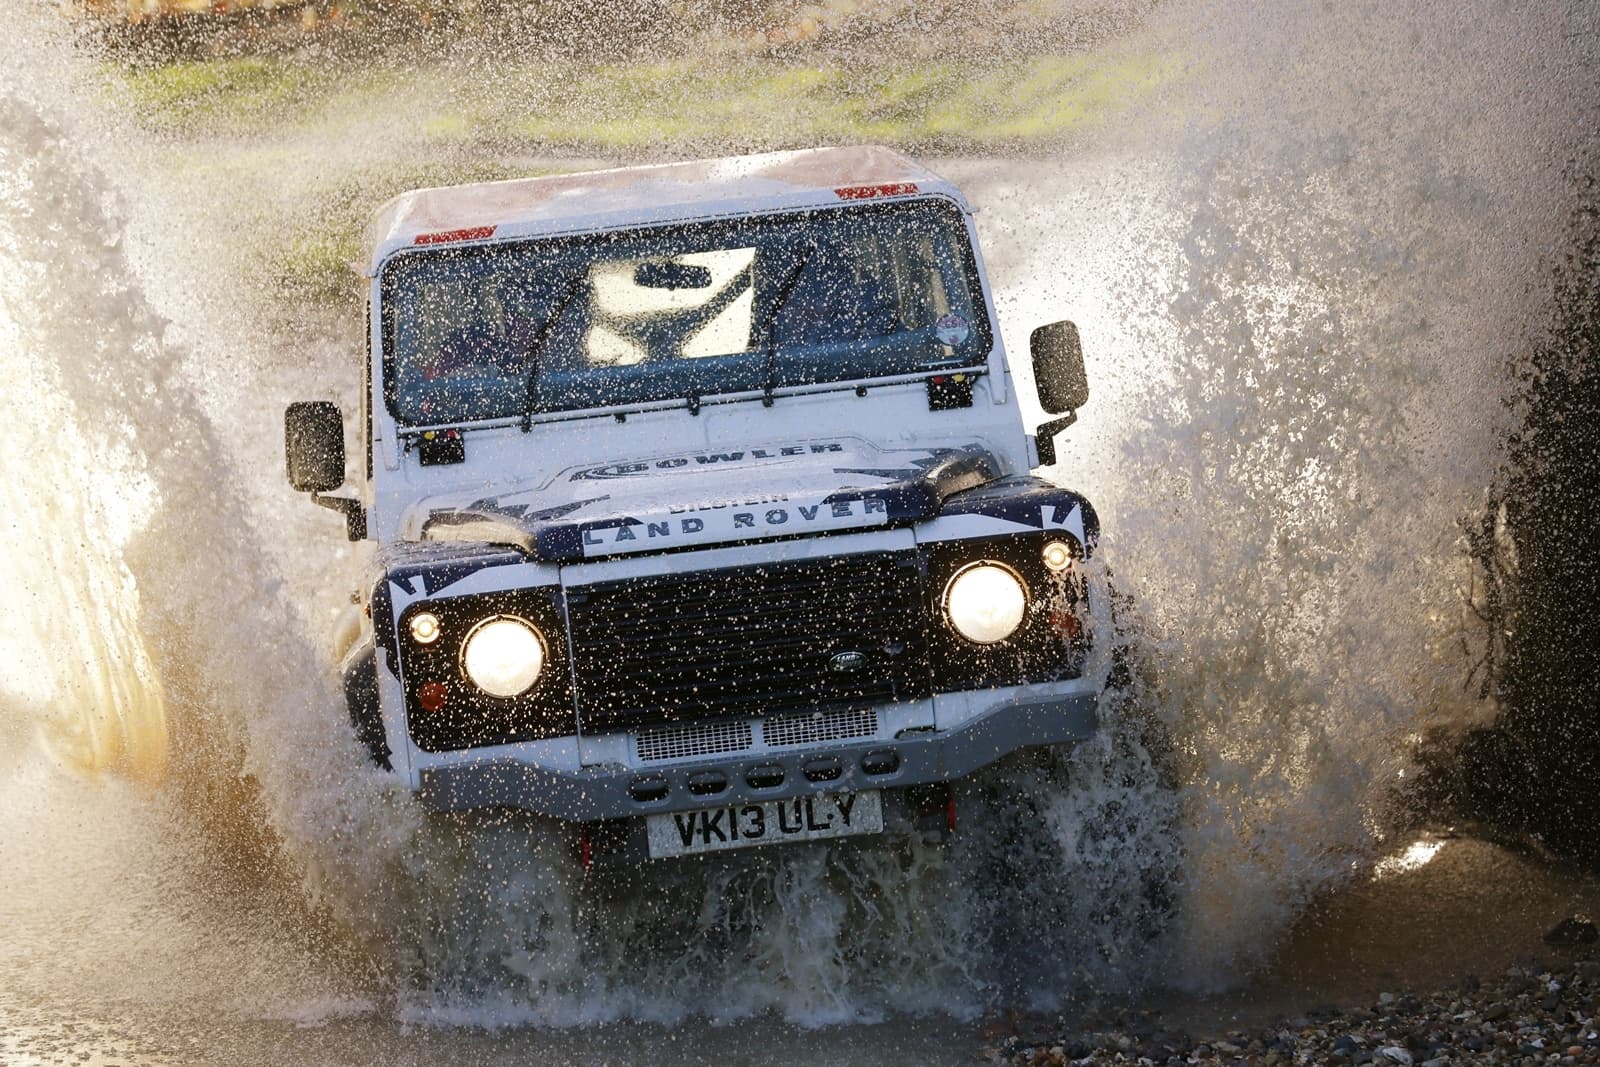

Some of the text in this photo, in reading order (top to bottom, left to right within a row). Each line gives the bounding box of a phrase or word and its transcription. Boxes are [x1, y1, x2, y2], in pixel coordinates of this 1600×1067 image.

[583, 517, 704, 545] LAND
[733, 499, 886, 529] ROVER
[674, 793, 856, 847] VK13 ULY
